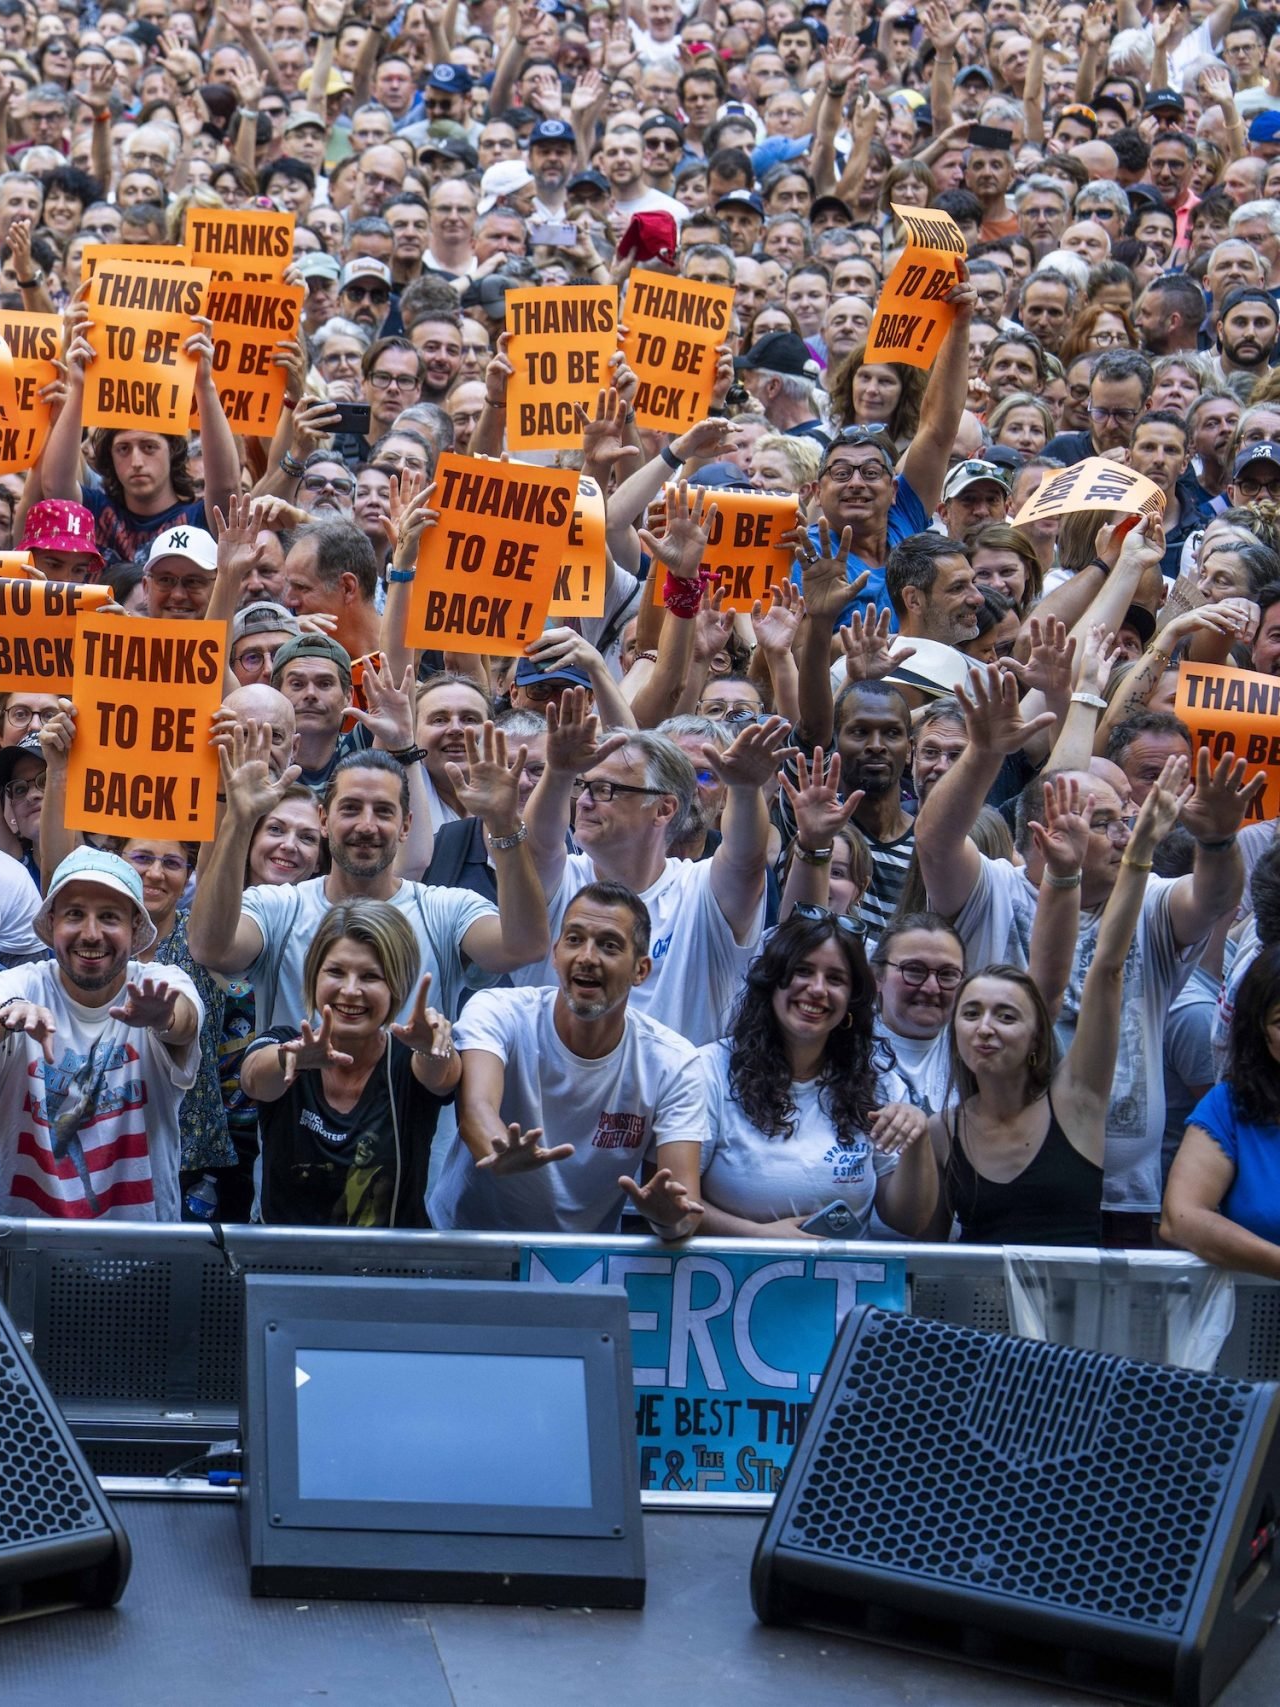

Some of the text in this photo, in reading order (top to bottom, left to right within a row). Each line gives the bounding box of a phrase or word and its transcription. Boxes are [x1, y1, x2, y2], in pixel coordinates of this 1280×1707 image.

[193, 222, 289, 257] THANKS
[902, 215, 965, 253] THANKS
[98, 273, 202, 316] THANKS
[896, 265, 955, 300] TO BE
[206, 291, 296, 331] HANKS
[511, 300, 613, 336] THANKS
[633, 281, 727, 330] THANKS
[106, 325, 180, 365] TO BE
[212, 339, 273, 377] O BE
[636, 333, 705, 374] TO BE
[525, 351, 599, 384] TO BE
[519, 402, 588, 437] BACK
[441, 469, 571, 528] THANKS
[734, 513, 773, 547] BE
[446, 531, 539, 581] TO BE
[44, 582, 83, 616] BE
[83, 631, 218, 684] THANKS
[1186, 674, 1280, 715] THAN
[97, 702, 195, 752] TO BE
[1197, 729, 1235, 761] TO
[636, 1394, 664, 1437] HE
[675, 1397, 742, 1437] BEST
[692, 1445, 724, 1468] THE
